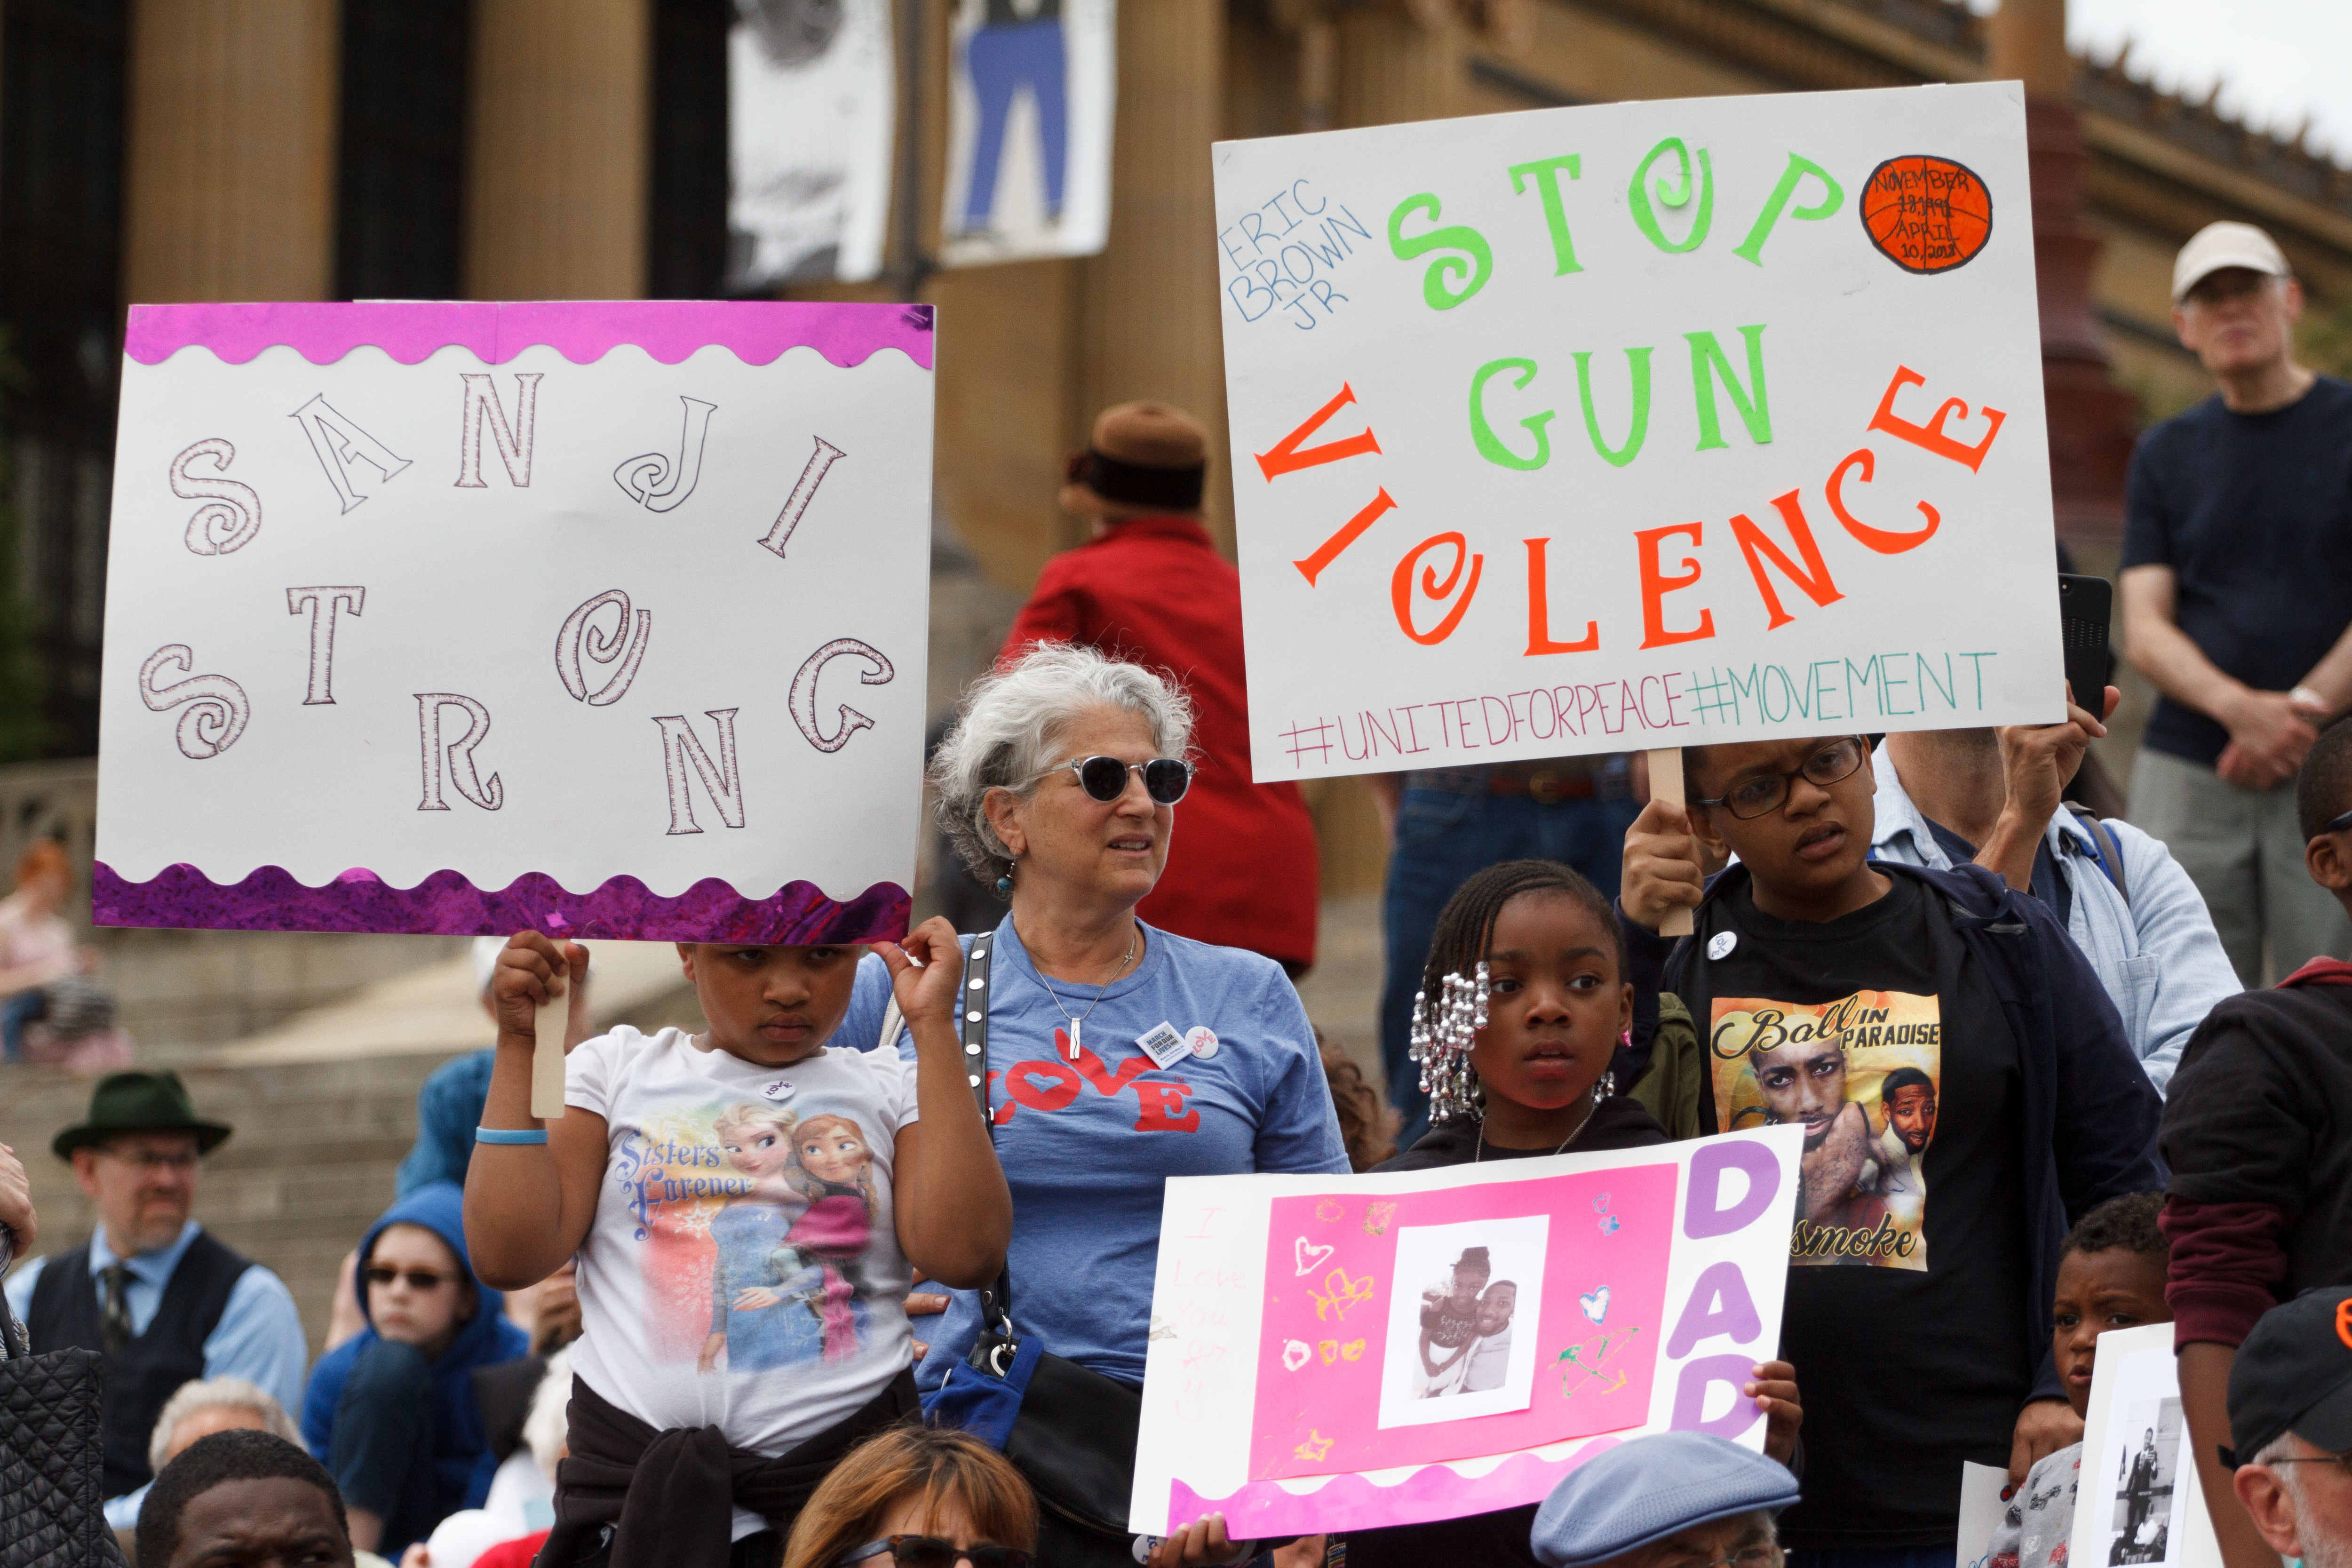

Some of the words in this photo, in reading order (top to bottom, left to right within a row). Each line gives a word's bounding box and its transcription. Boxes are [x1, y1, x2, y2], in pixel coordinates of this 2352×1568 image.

[1874, 168, 1970, 193] NOVEMBER
[1219, 179, 1326, 271] ERIC
[1388, 137, 1844, 310] STOP
[1896, 220, 1960, 240] APRIL
[1229, 204, 1372, 322] BROWN
[1284, 280, 1348, 330] JR
[1470, 324, 1772, 470] GUN
[170, 373, 847, 559] SANJI
[1254, 365, 2007, 657] VIOLENCE
[139, 586, 894, 835] STRONG
[1712, 934, 1729, 957] LOVE
[1146, 1031, 1167, 1045] MARCH
[1155, 1043, 1172, 1055] LIVES
[1192, 1029, 1216, 1054] LOVE
[1714, 994, 1860, 1060] Ball
[1858, 1008, 1890, 1025] IN
[1839, 1022, 1941, 1050] PARADISE
[765, 1081, 793, 1096] LOVE
[614, 1128, 721, 1182] Sisters
[620, 1168, 754, 1241] Forever
[1788, 1211, 1917, 1258] smoke
[1666, 1140, 1781, 1441] DAD
